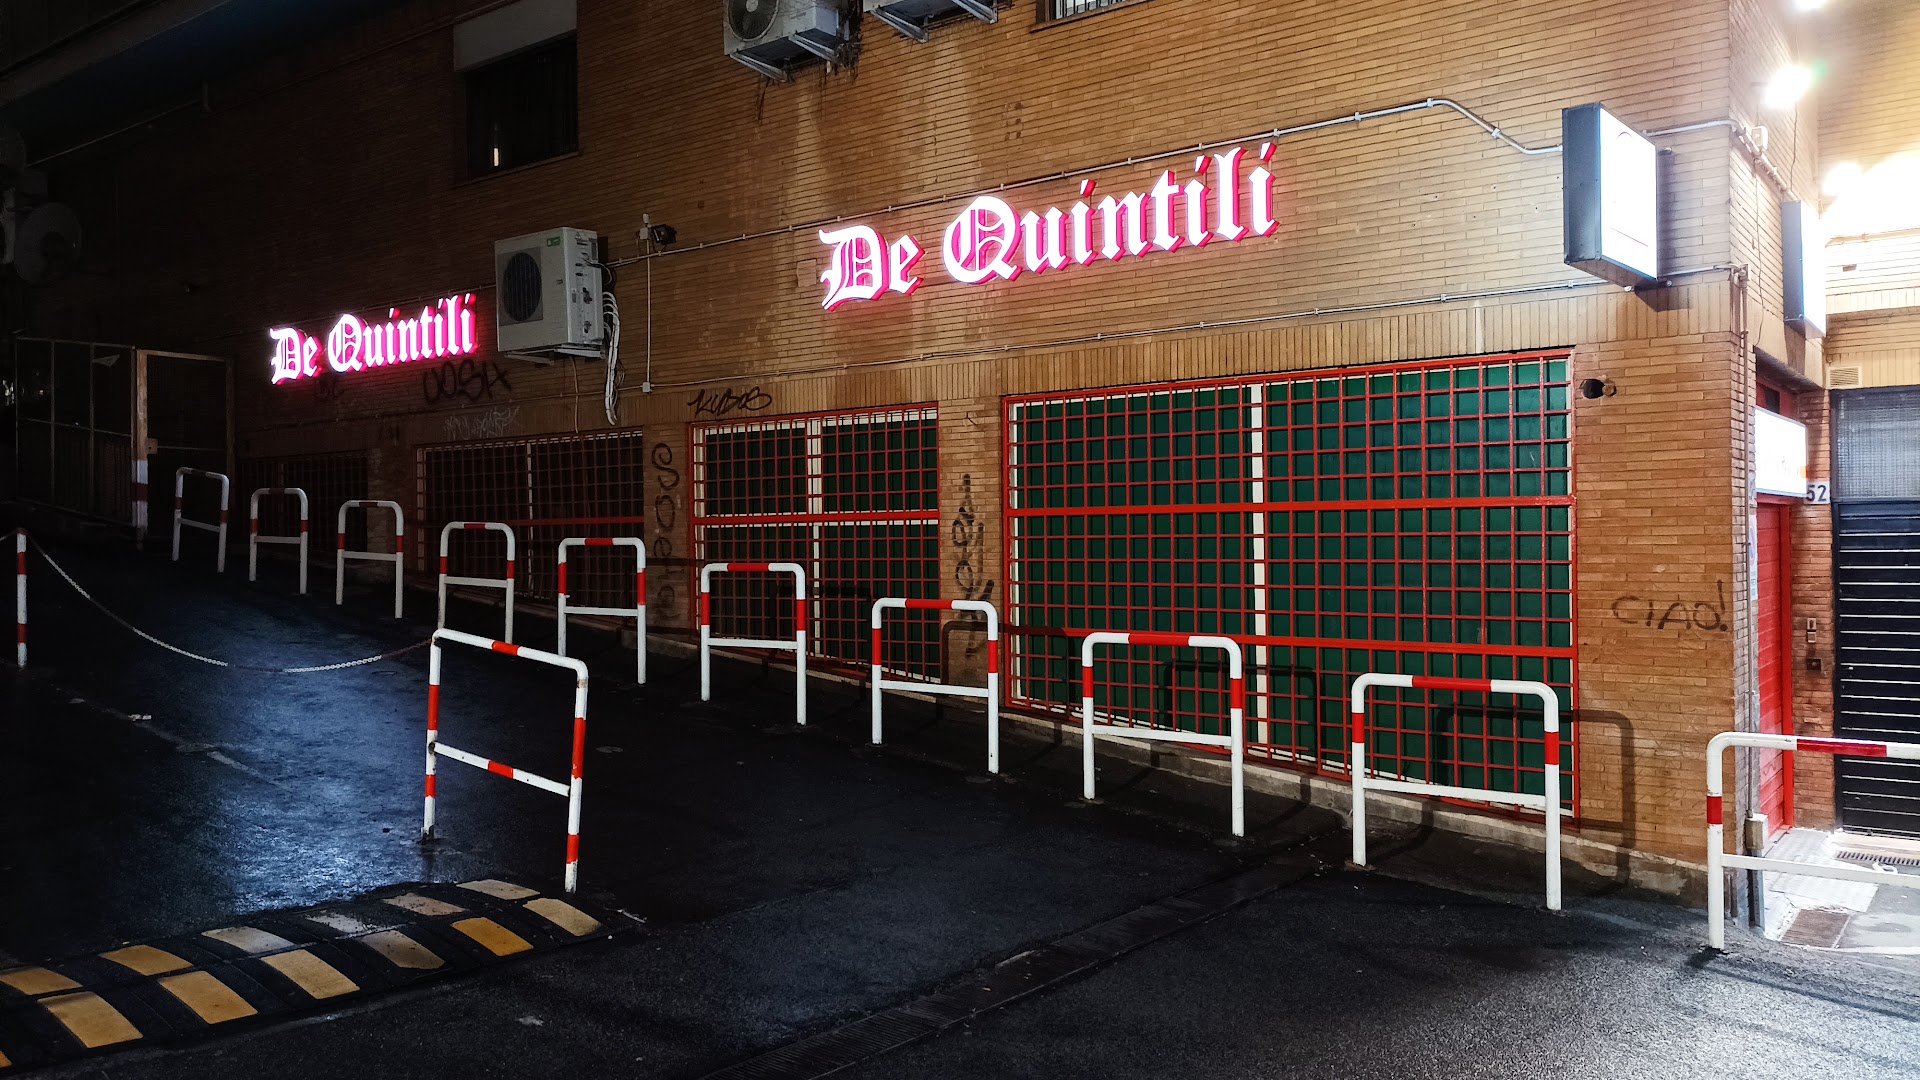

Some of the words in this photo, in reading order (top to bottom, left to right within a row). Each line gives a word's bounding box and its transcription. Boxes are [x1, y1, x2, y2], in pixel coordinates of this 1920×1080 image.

[819, 224, 924, 311] De
[943, 141, 1281, 284] Quintili
[270, 327, 323, 386] De
[328, 292, 479, 373] Quintili
[1806, 484, 1827, 502] 52
[1611, 579, 1728, 632] CIAO!
